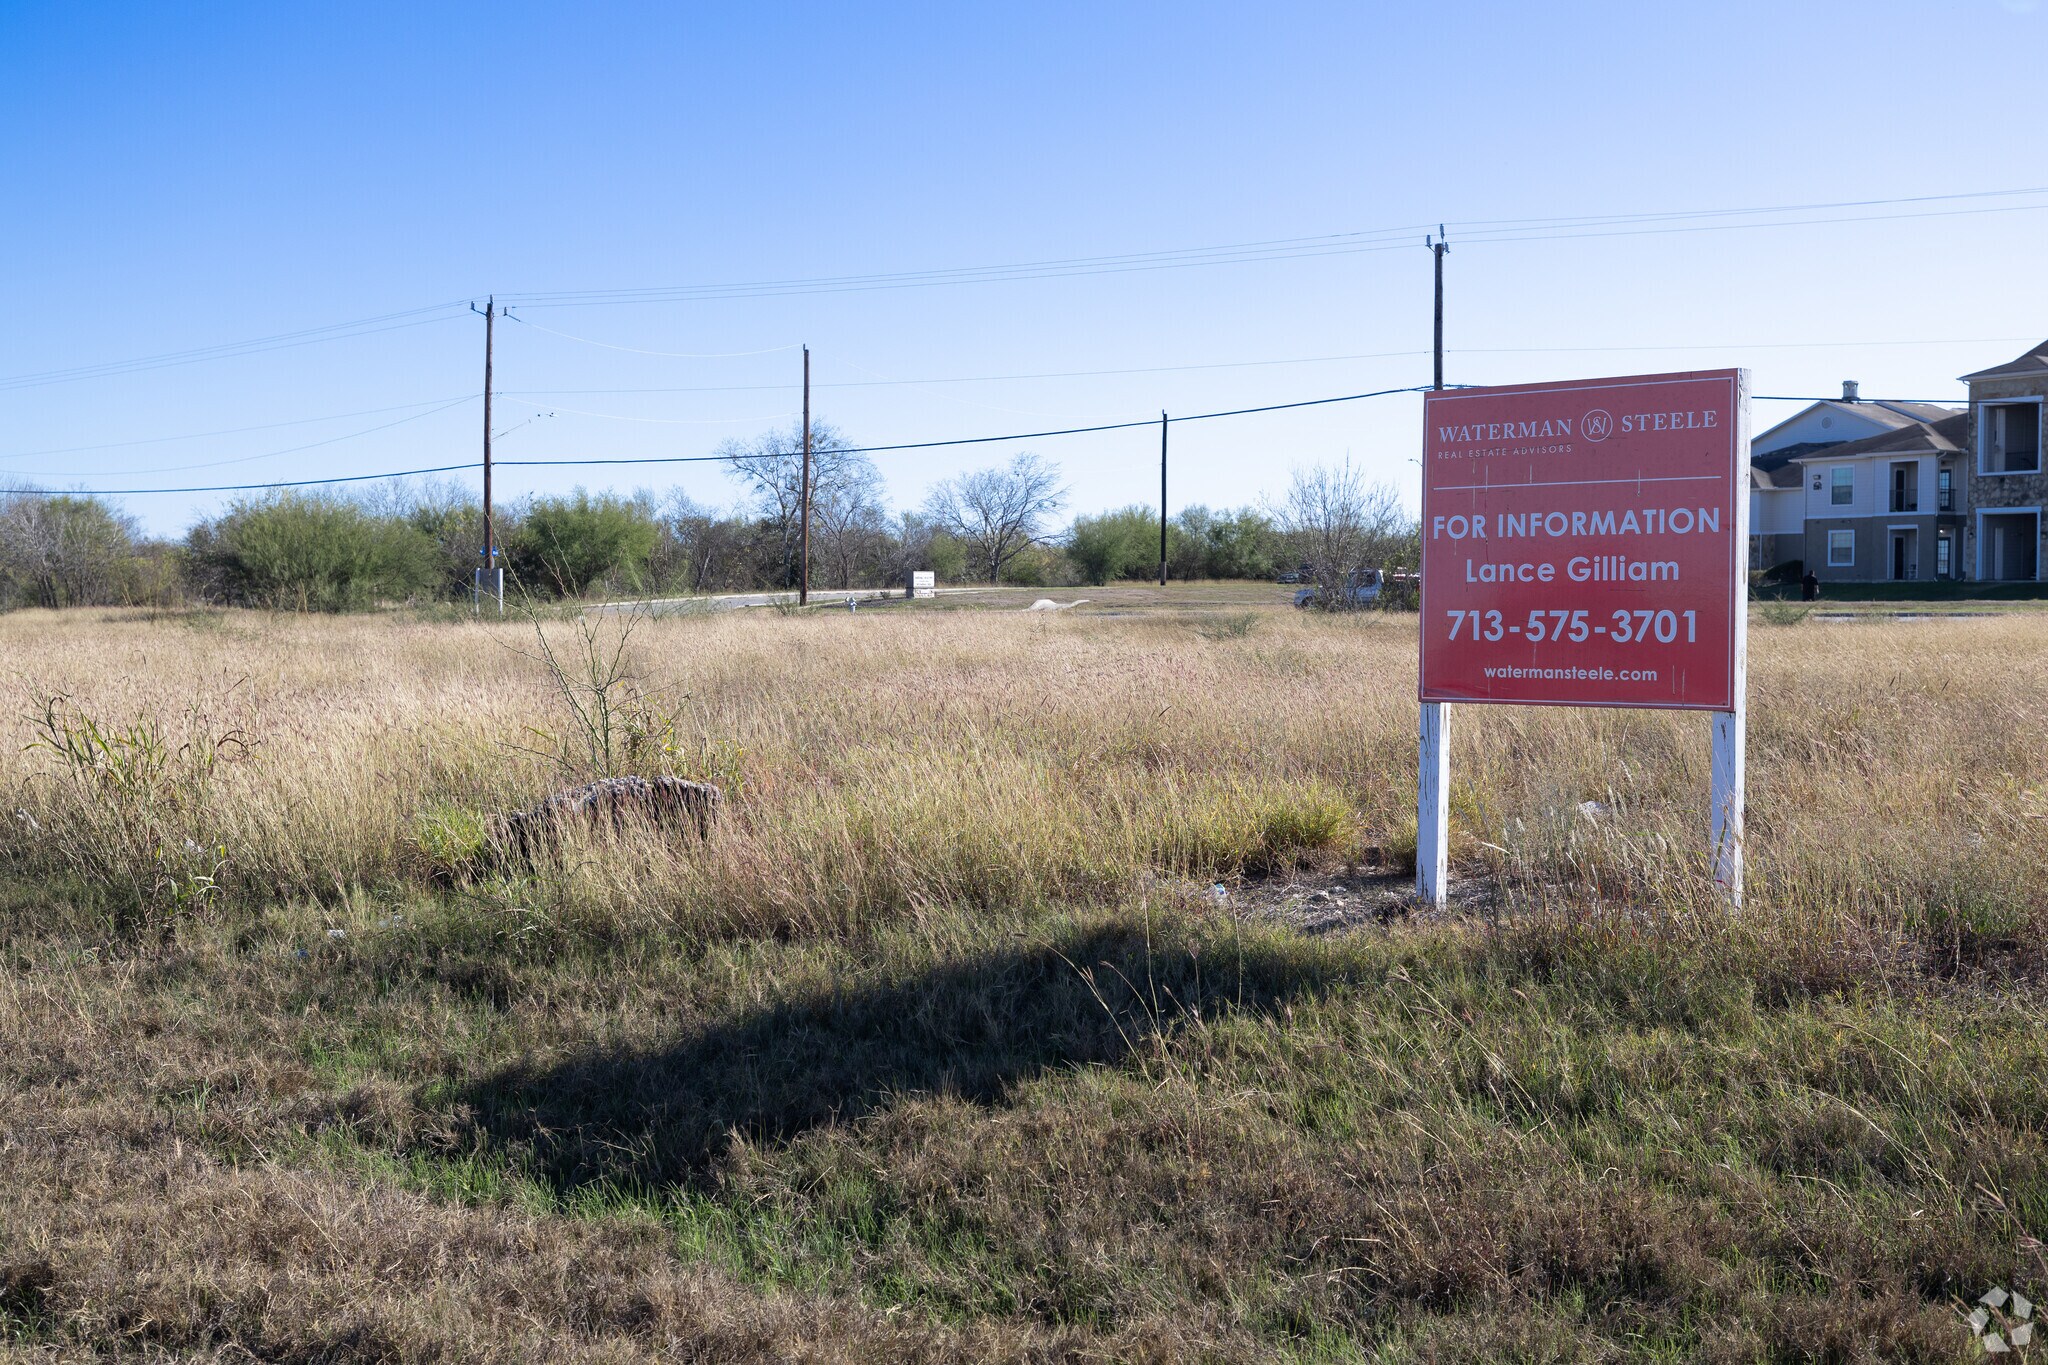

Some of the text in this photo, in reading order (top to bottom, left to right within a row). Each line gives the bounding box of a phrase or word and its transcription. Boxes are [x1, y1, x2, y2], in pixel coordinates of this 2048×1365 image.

[1439, 418, 1572, 444] WATERMAN
[1621, 410, 1718, 433] STEELE
[1438, 444, 1573, 459] REAL ESTATE ADVISORS
[1433, 507, 1720, 540] FOR INFORMATION
[1466, 556, 1680, 583] Lance Gilliam
[1446, 609, 1696, 643] 713-575-3701
[1483, 665, 1657, 682] watermansteele.com
